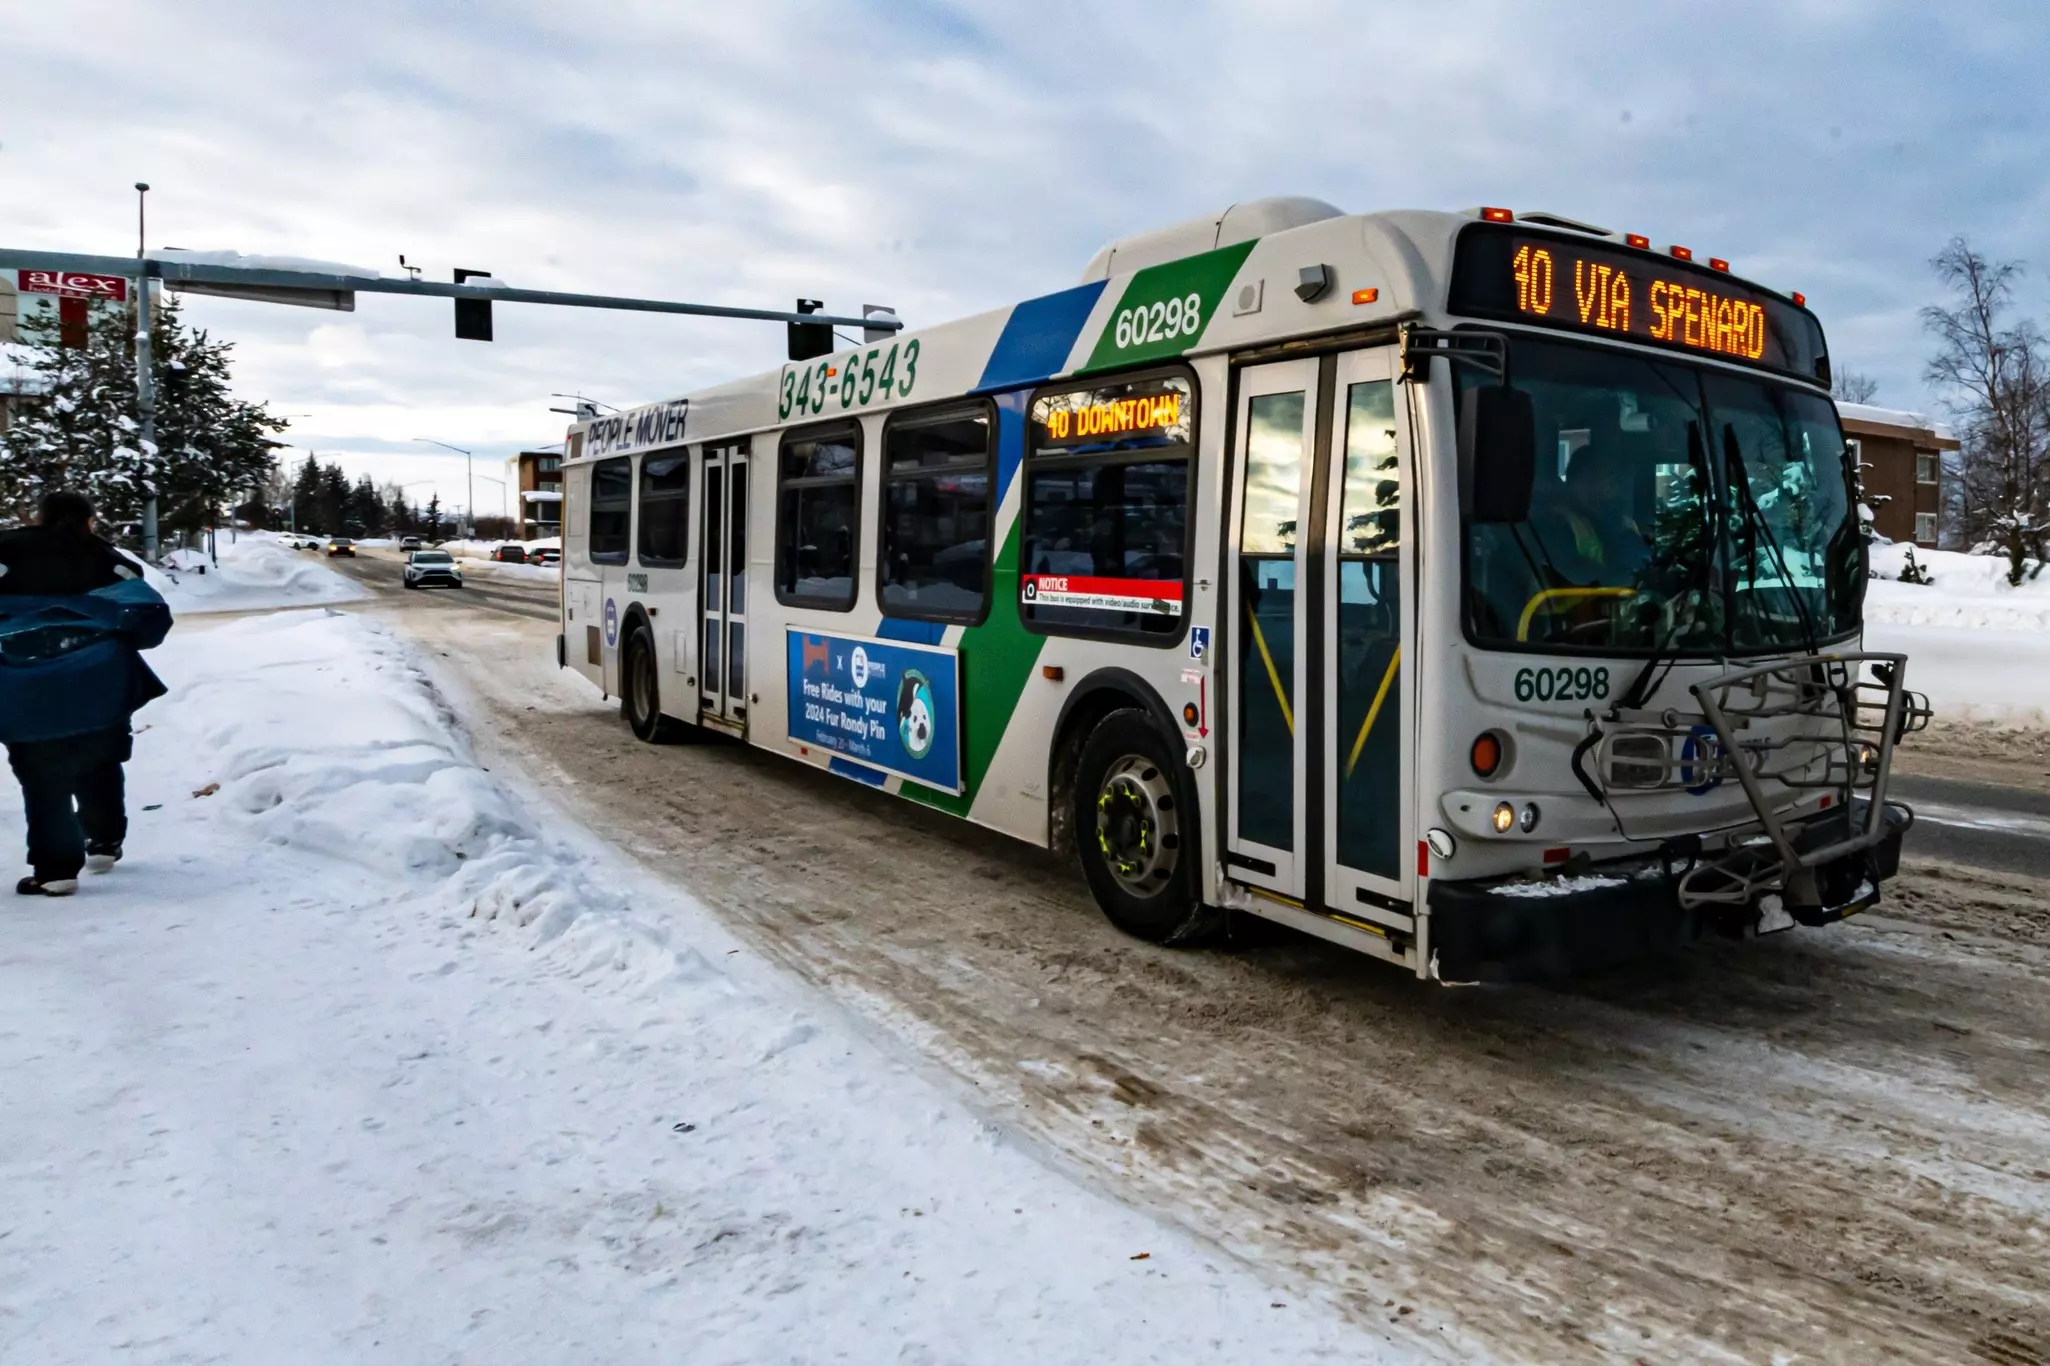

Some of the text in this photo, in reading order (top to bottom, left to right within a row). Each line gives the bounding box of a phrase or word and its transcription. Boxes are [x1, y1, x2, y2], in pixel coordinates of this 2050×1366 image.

[28, 271, 117, 292] alex
[1115, 293, 1201, 349] 60298
[1514, 246, 1765, 359] 40 VIA SPENARD
[779, 338, 920, 420] 343-6543
[587, 398, 689, 456] PEOPLE MOVER
[1077, 393, 1180, 437] DOWNTOWN
[1038, 577, 1068, 592] NOTICE
[1065, 596, 1091, 605] equipped
[1092, 598, 1104, 606] with
[803, 679, 887, 716] Free Rides with your
[1514, 666, 1610, 702] 60298
[805, 703, 886, 740] 2024 Fur Rondy Pin
